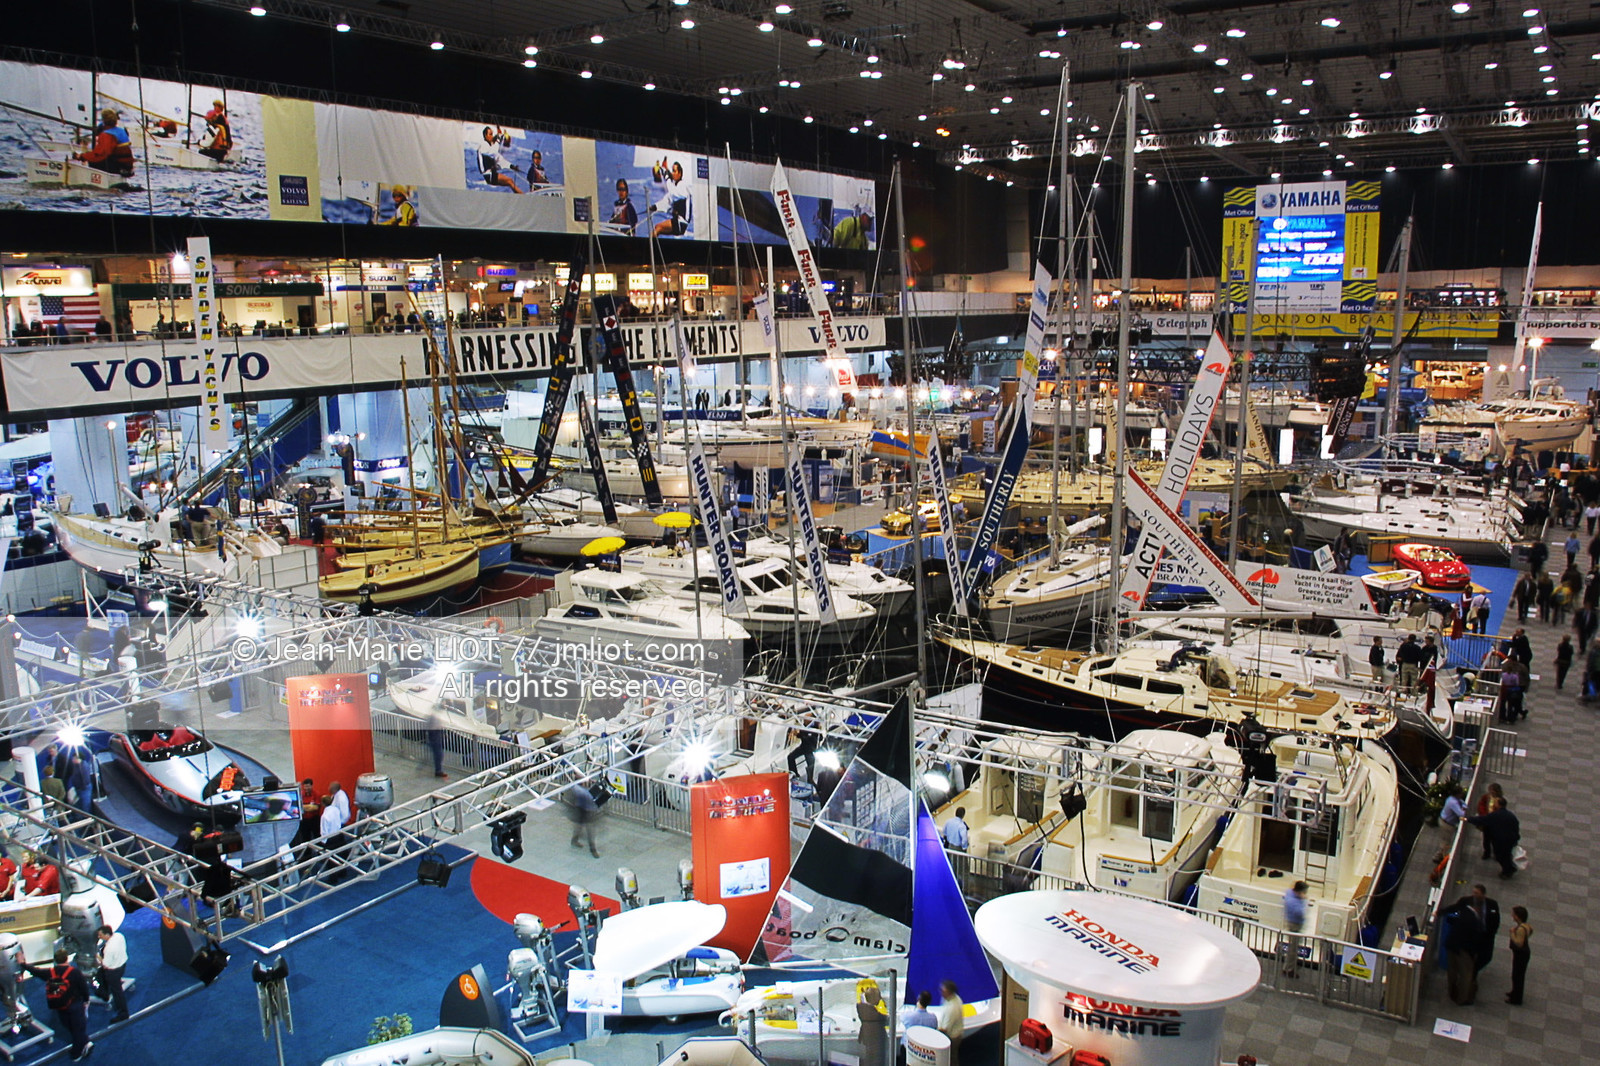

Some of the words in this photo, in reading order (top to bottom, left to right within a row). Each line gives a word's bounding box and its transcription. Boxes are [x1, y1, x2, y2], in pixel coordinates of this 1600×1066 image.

[1280, 190, 1341, 208] YAMAHA
[226, 284, 260, 296] SONIC
[194, 256, 212, 340] SWEDEN
[204, 349, 220, 431] YACHTS
[652, 325, 738, 357] ELMENTS
[1164, 393, 1214, 494] HOLIDAYS
[692, 456, 720, 538] HUNTER
[714, 539, 738, 603] BOATS
[980, 470, 1016, 550] SOUTHERLY
[791, 461, 814, 545] HUNTER
[809, 548, 830, 612] BOATS
[1141, 508, 1208, 578] SOUTHERLY
[1208, 580, 1226, 598] 135
[946, 539, 963, 603] BOATS
[1156, 574, 1185, 583] BRAY
[1294, 580, 1312, 588] Yacht
[1321, 582, 1335, 590] four
[1296, 573, 1317, 581] Learn
[1298, 586, 1323, 596] Greece,
[1324, 590, 1349, 599] Croatia
[1302, 594, 1324, 604] Turkey
[1044, 915, 1150, 975] MARINE
[1062, 908, 1160, 968] HONDA
[1063, 1004, 1182, 1036] MARINE
